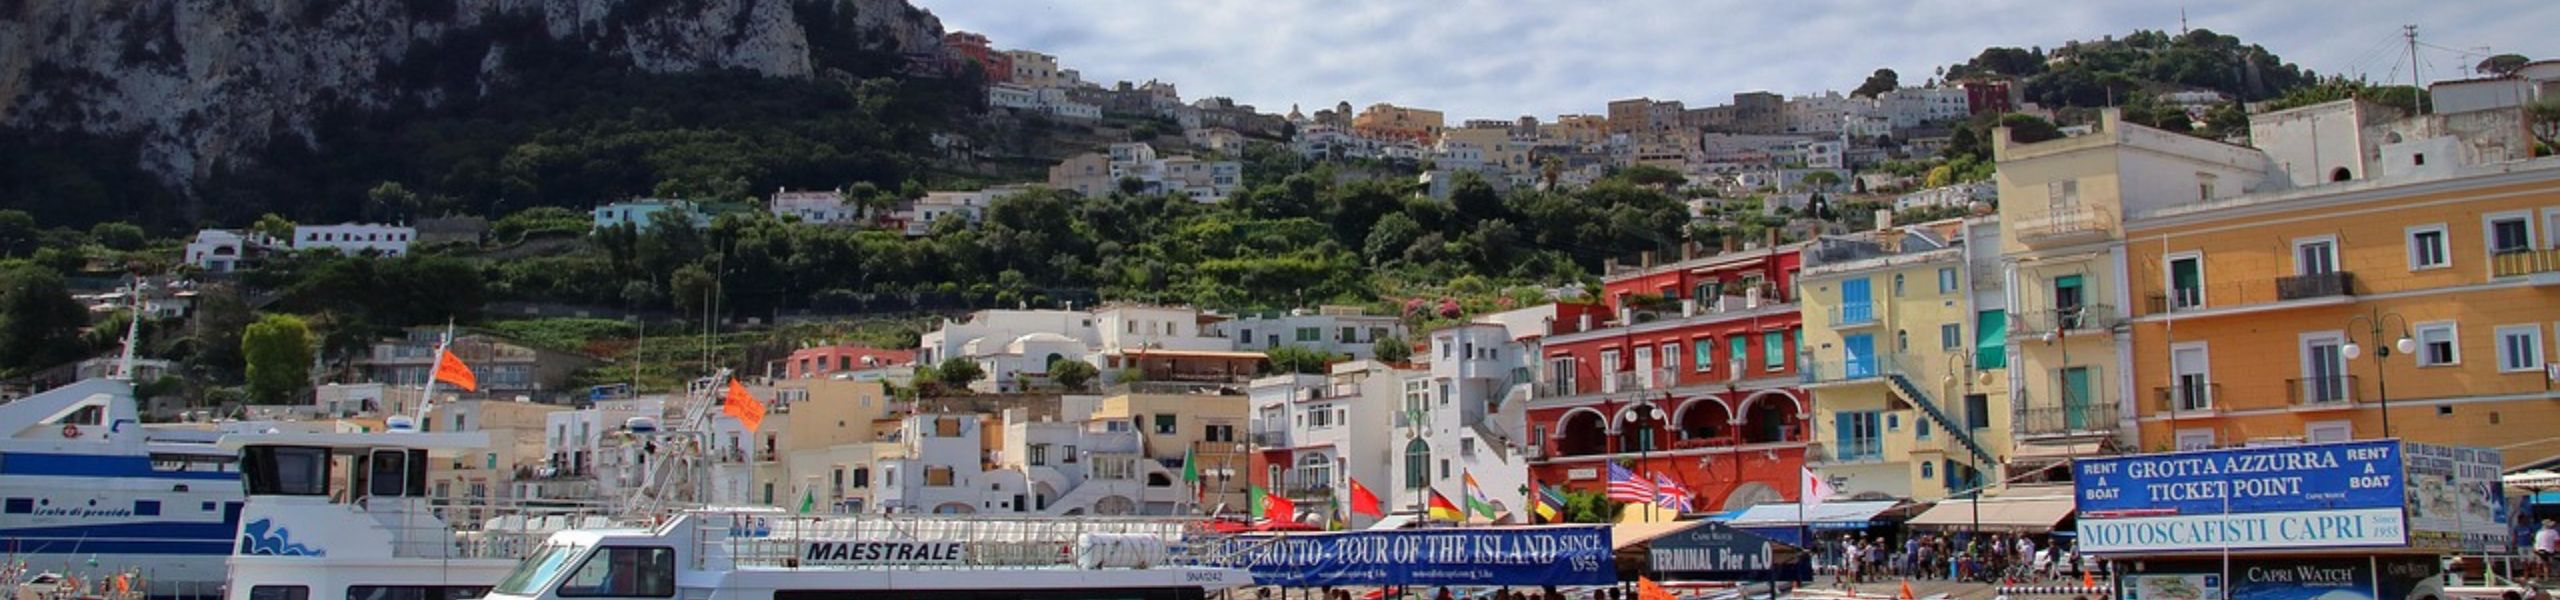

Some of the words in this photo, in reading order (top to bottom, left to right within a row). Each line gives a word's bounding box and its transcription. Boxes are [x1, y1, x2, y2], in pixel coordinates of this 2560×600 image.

[2347, 447, 2389, 460] RENT
[2084, 463, 2117, 475] RENT
[2128, 458, 2218, 479] GROTTA
[2224, 451, 2339, 474] AZZURRA
[2364, 462, 2375, 474] A
[2098, 476, 2107, 487] A
[2147, 481, 2227, 501] TICKET
[2232, 477, 2303, 498] POINT
[2350, 475, 2391, 489] BOAT
[2086, 488, 2120, 500] BOAT
[2084, 519, 2268, 547] MOTOSCAFISTI
[2280, 515, 2364, 541] CAPRI
[807, 542, 961, 560] MAESTRALE
[1335, 535, 1389, 564] TOUR
[1393, 535, 1421, 564] OF
[1425, 534, 1468, 564] THE
[1473, 534, 1556, 564] ISLAND
[1558, 533, 1602, 550] SINCE
[1570, 554, 1599, 572] 1955
[1651, 548, 1712, 570] TERMINAL
[1719, 546, 1744, 570] Pier
[2249, 566, 2293, 583] CAPRI
[2297, 565, 2352, 581] WATCH
